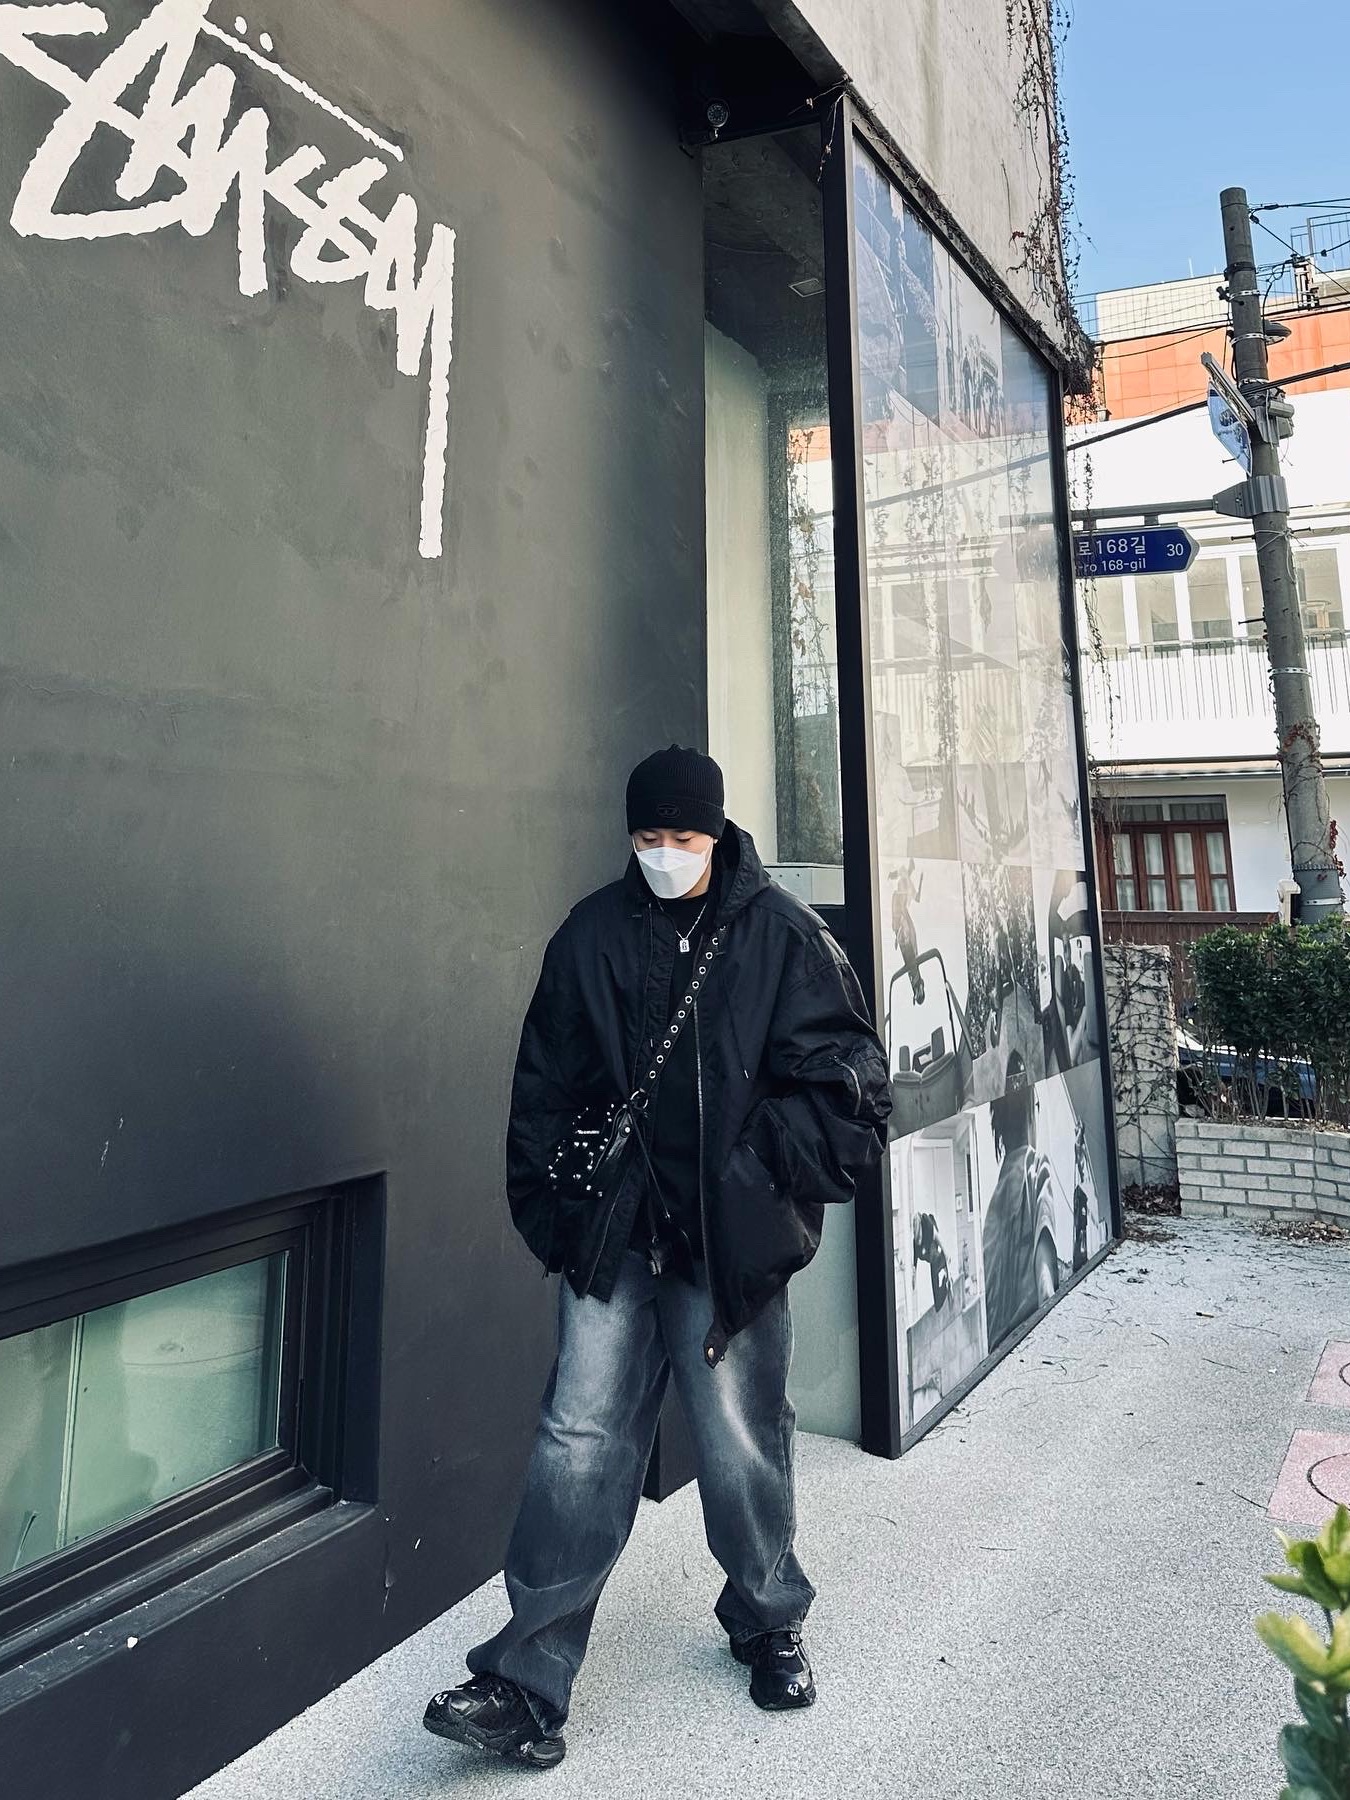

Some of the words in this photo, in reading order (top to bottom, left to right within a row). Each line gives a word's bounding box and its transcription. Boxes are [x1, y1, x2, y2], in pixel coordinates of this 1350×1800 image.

[1166, 543, 1184, 557] 30
[1101, 558, 1146, 572] 168-gil
[787, 1683, 800, 1696] 42
